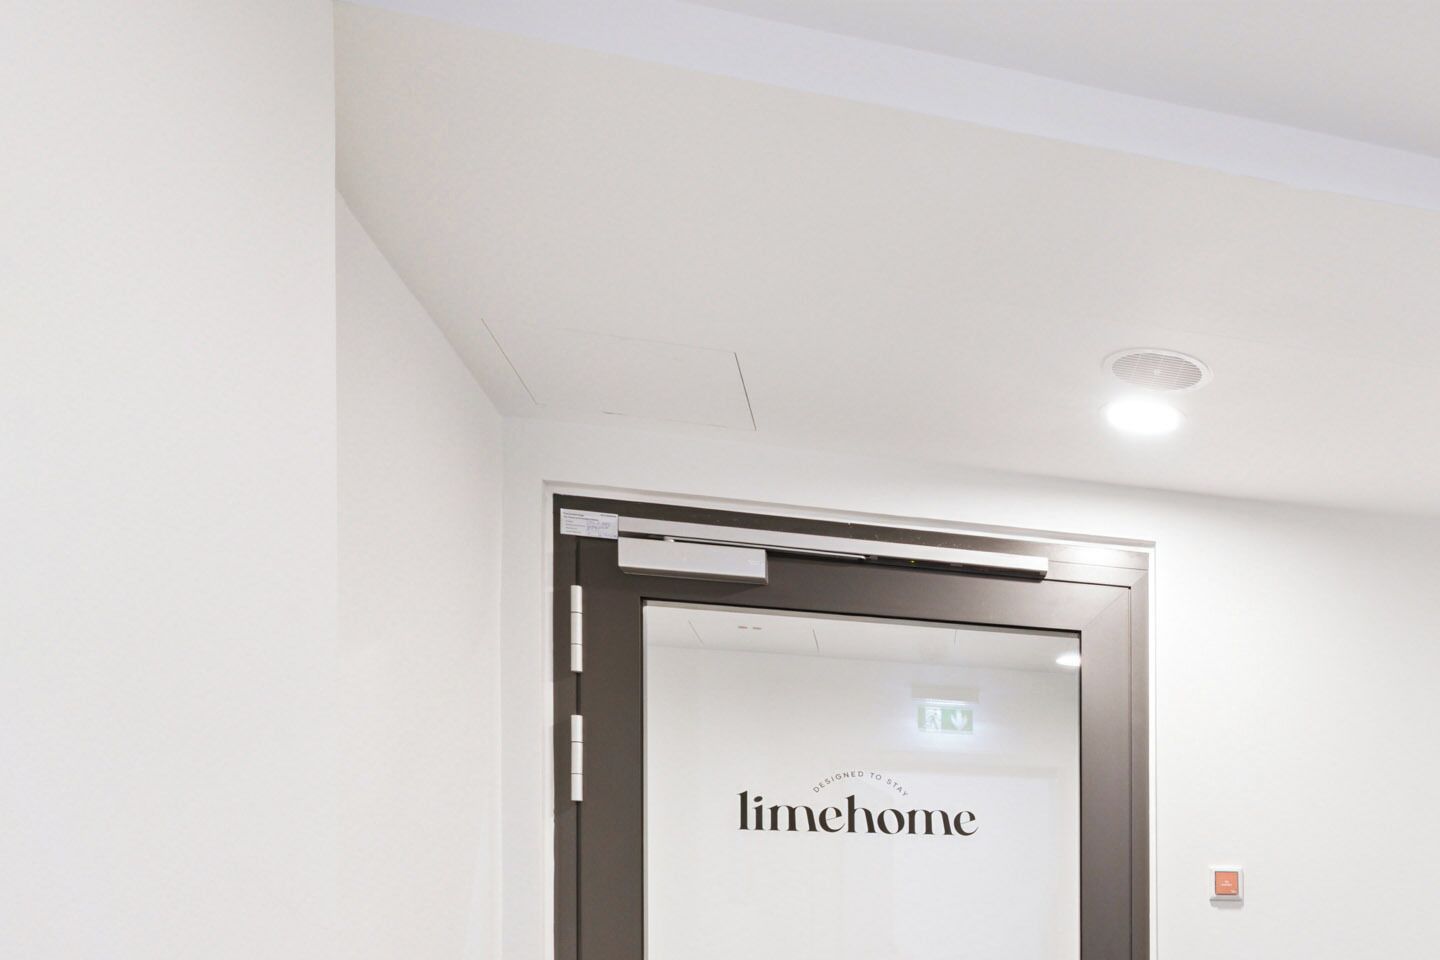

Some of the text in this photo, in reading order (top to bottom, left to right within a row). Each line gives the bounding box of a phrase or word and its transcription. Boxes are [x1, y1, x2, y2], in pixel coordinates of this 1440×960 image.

[813, 771, 909, 796] DESIGNED TO STAY
[737, 790, 979, 836] limehome
